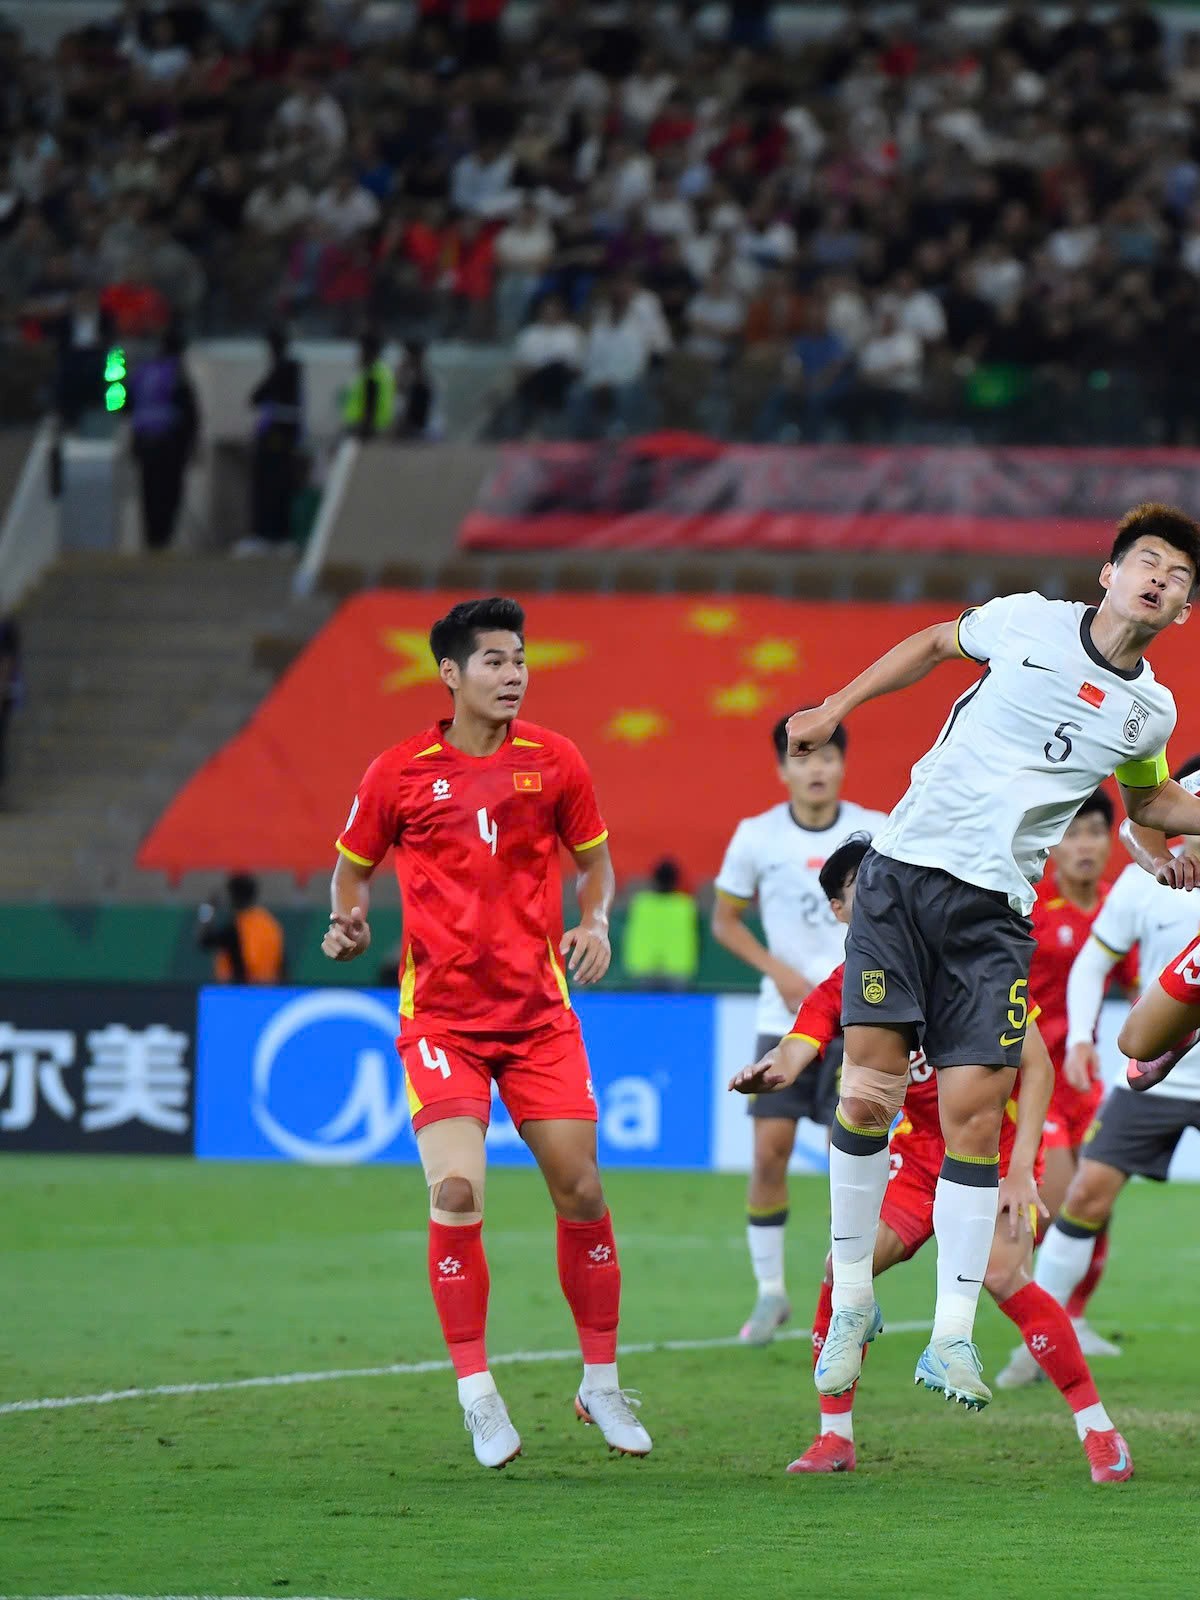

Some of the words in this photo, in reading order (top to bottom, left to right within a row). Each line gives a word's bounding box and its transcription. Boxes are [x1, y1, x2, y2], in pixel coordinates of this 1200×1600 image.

[1044, 721, 1083, 764] 5
[477, 806, 498, 856] 4
[864, 972, 882, 980] CFA
[1006, 978, 1028, 1030] 5
[418, 1037, 451, 1080] 4
